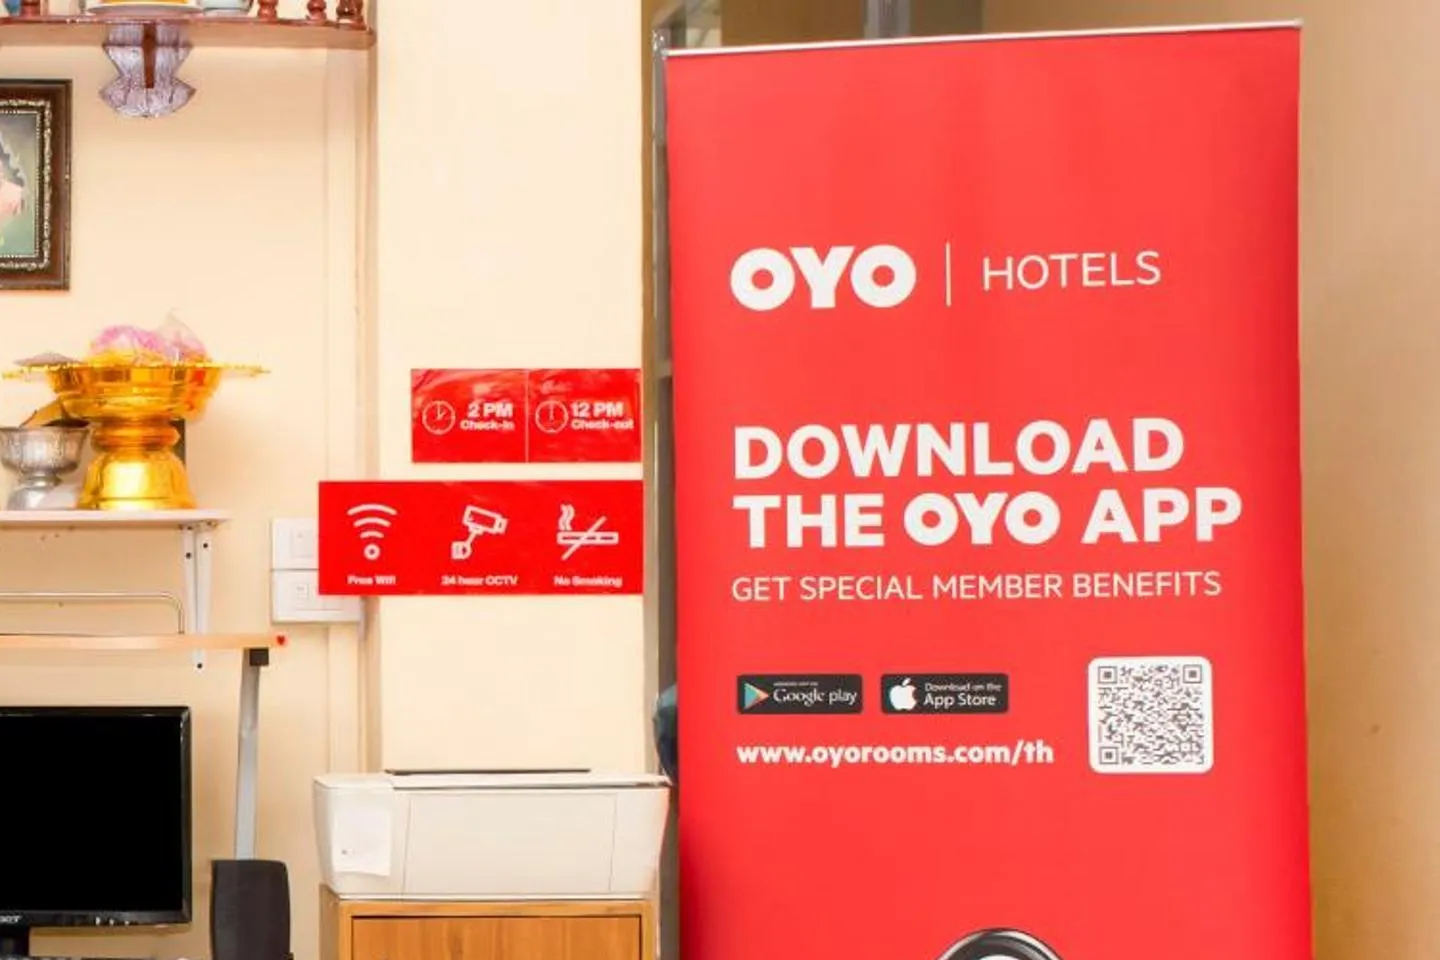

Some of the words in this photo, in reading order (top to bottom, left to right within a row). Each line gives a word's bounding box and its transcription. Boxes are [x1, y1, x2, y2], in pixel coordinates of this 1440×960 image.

[730, 244, 917, 312] OYO
[982, 250, 1162, 291] HOTELS
[467, 402, 480, 418] 2
[483, 402, 514, 418] PM
[572, 402, 590, 417] 12
[593, 402, 625, 417] PM
[460, 420, 515, 431] Check-in
[571, 419, 635, 430] Check-out
[733, 417, 1185, 480] DOWNLOAD
[732, 493, 886, 549] THE
[903, 490, 1061, 547] OYO
[1081, 486, 1243, 545] APP
[731, 576, 791, 601] GET
[800, 575, 923, 601] SPECIAL
[932, 573, 1063, 599] MEMBER
[1072, 570, 1222, 598] BENEFITS
[773, 688, 825, 707] Google
[829, 688, 857, 706] play
[923, 693, 955, 709] App
[957, 693, 997, 706] Store
[736, 739, 1055, 769] www.oyorooms.com/th
